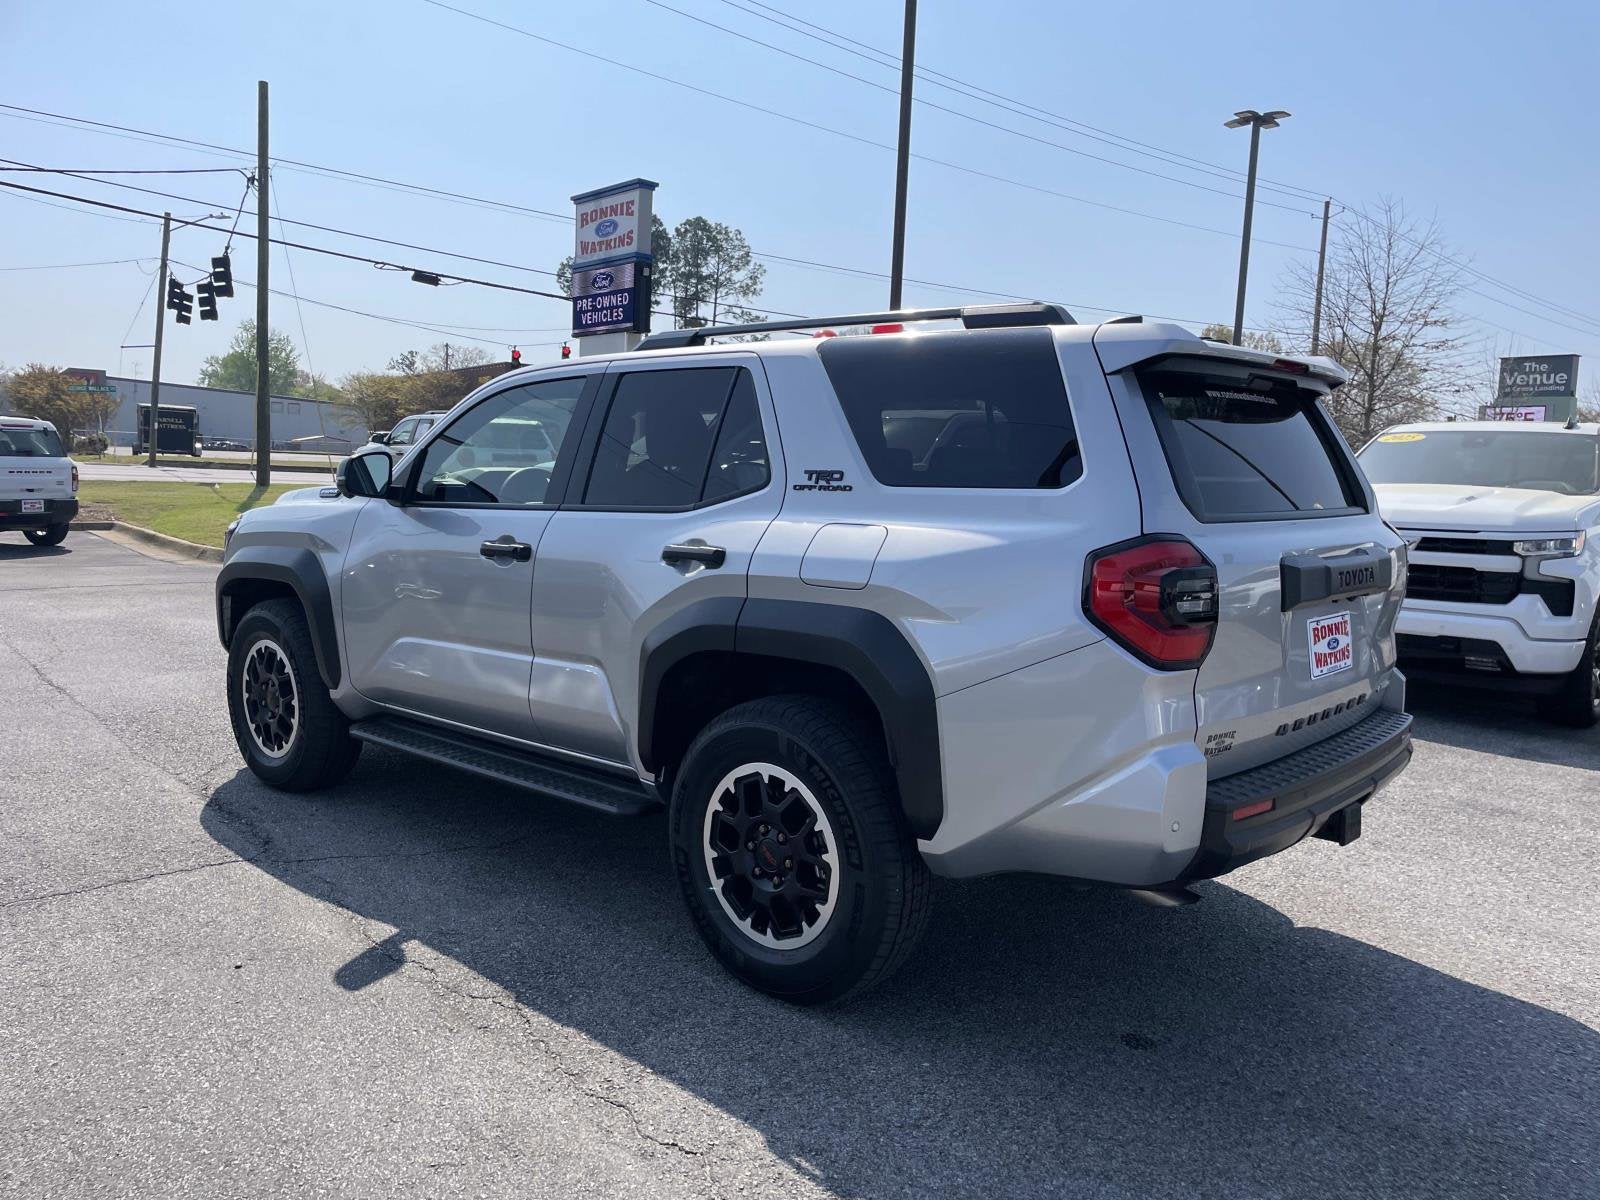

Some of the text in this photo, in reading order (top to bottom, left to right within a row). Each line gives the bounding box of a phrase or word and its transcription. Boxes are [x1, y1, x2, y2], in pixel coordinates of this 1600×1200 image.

[580, 200, 635, 229] RONNIE
[580, 229, 634, 255] WATKINS
[576, 292, 629, 311] PRE-OWNED
[581, 307, 624, 324] VEHICLES
[1523, 362, 1549, 372] The
[1503, 371, 1568, 386] Venue
[1534, 384, 1565, 392] Landing
[804, 469, 845, 485] TRD
[1338, 567, 1375, 588] TOYOTA
[1311, 619, 1349, 645] RONNIE
[1314, 643, 1350, 669] WATKINS
[1206, 730, 1237, 745] RONNIE
[1204, 742, 1234, 757] WATKINS
